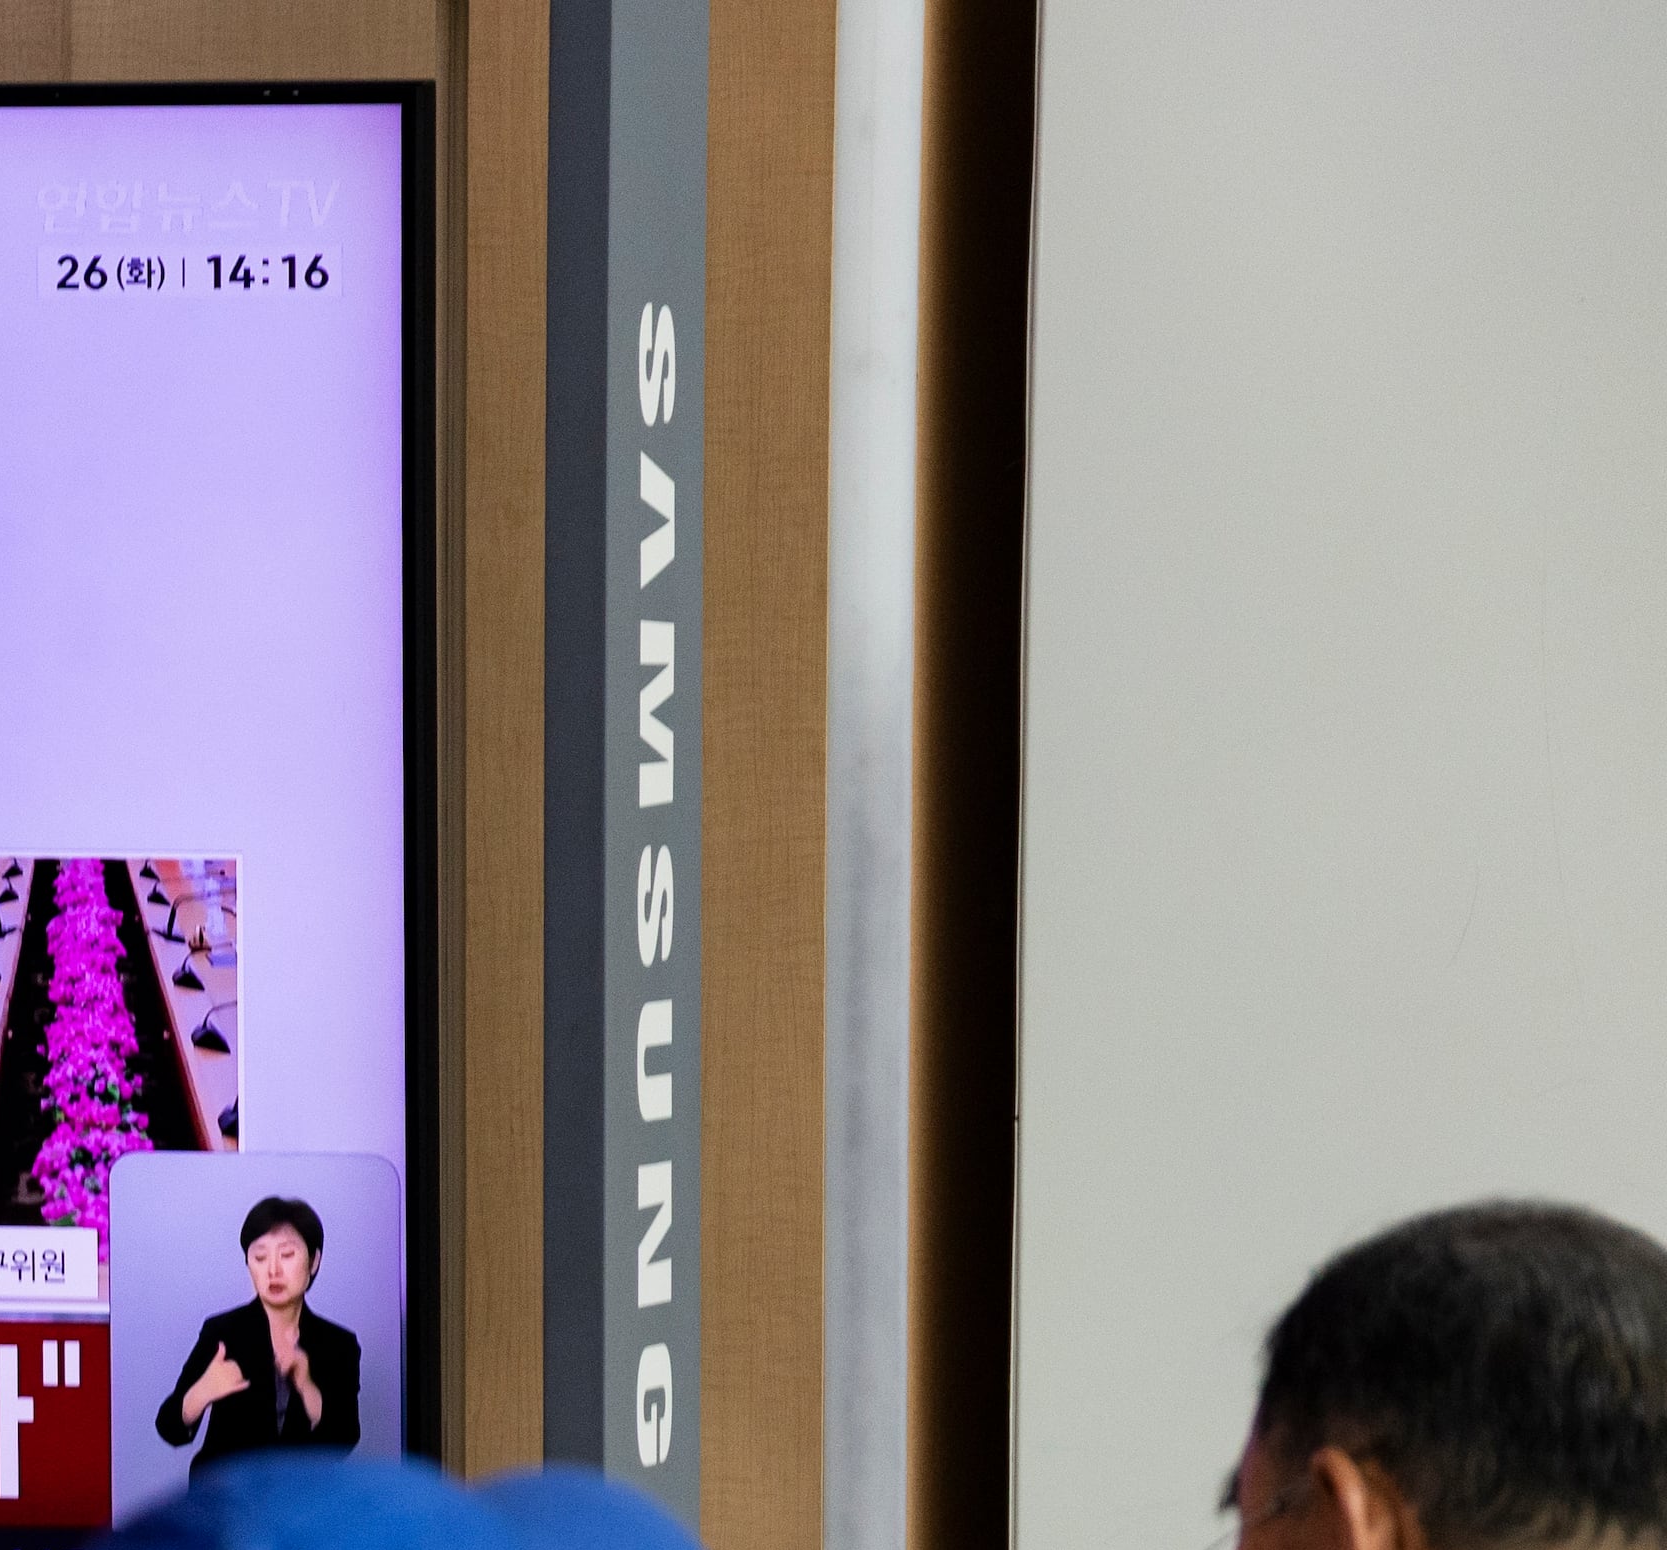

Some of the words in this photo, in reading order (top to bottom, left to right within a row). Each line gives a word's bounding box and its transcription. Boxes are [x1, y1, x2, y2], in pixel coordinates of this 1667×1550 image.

[56, 254, 165, 291] 26(화)
[206, 253, 329, 290] 14:16
[636, 302, 676, 1469] SAMSUNG
